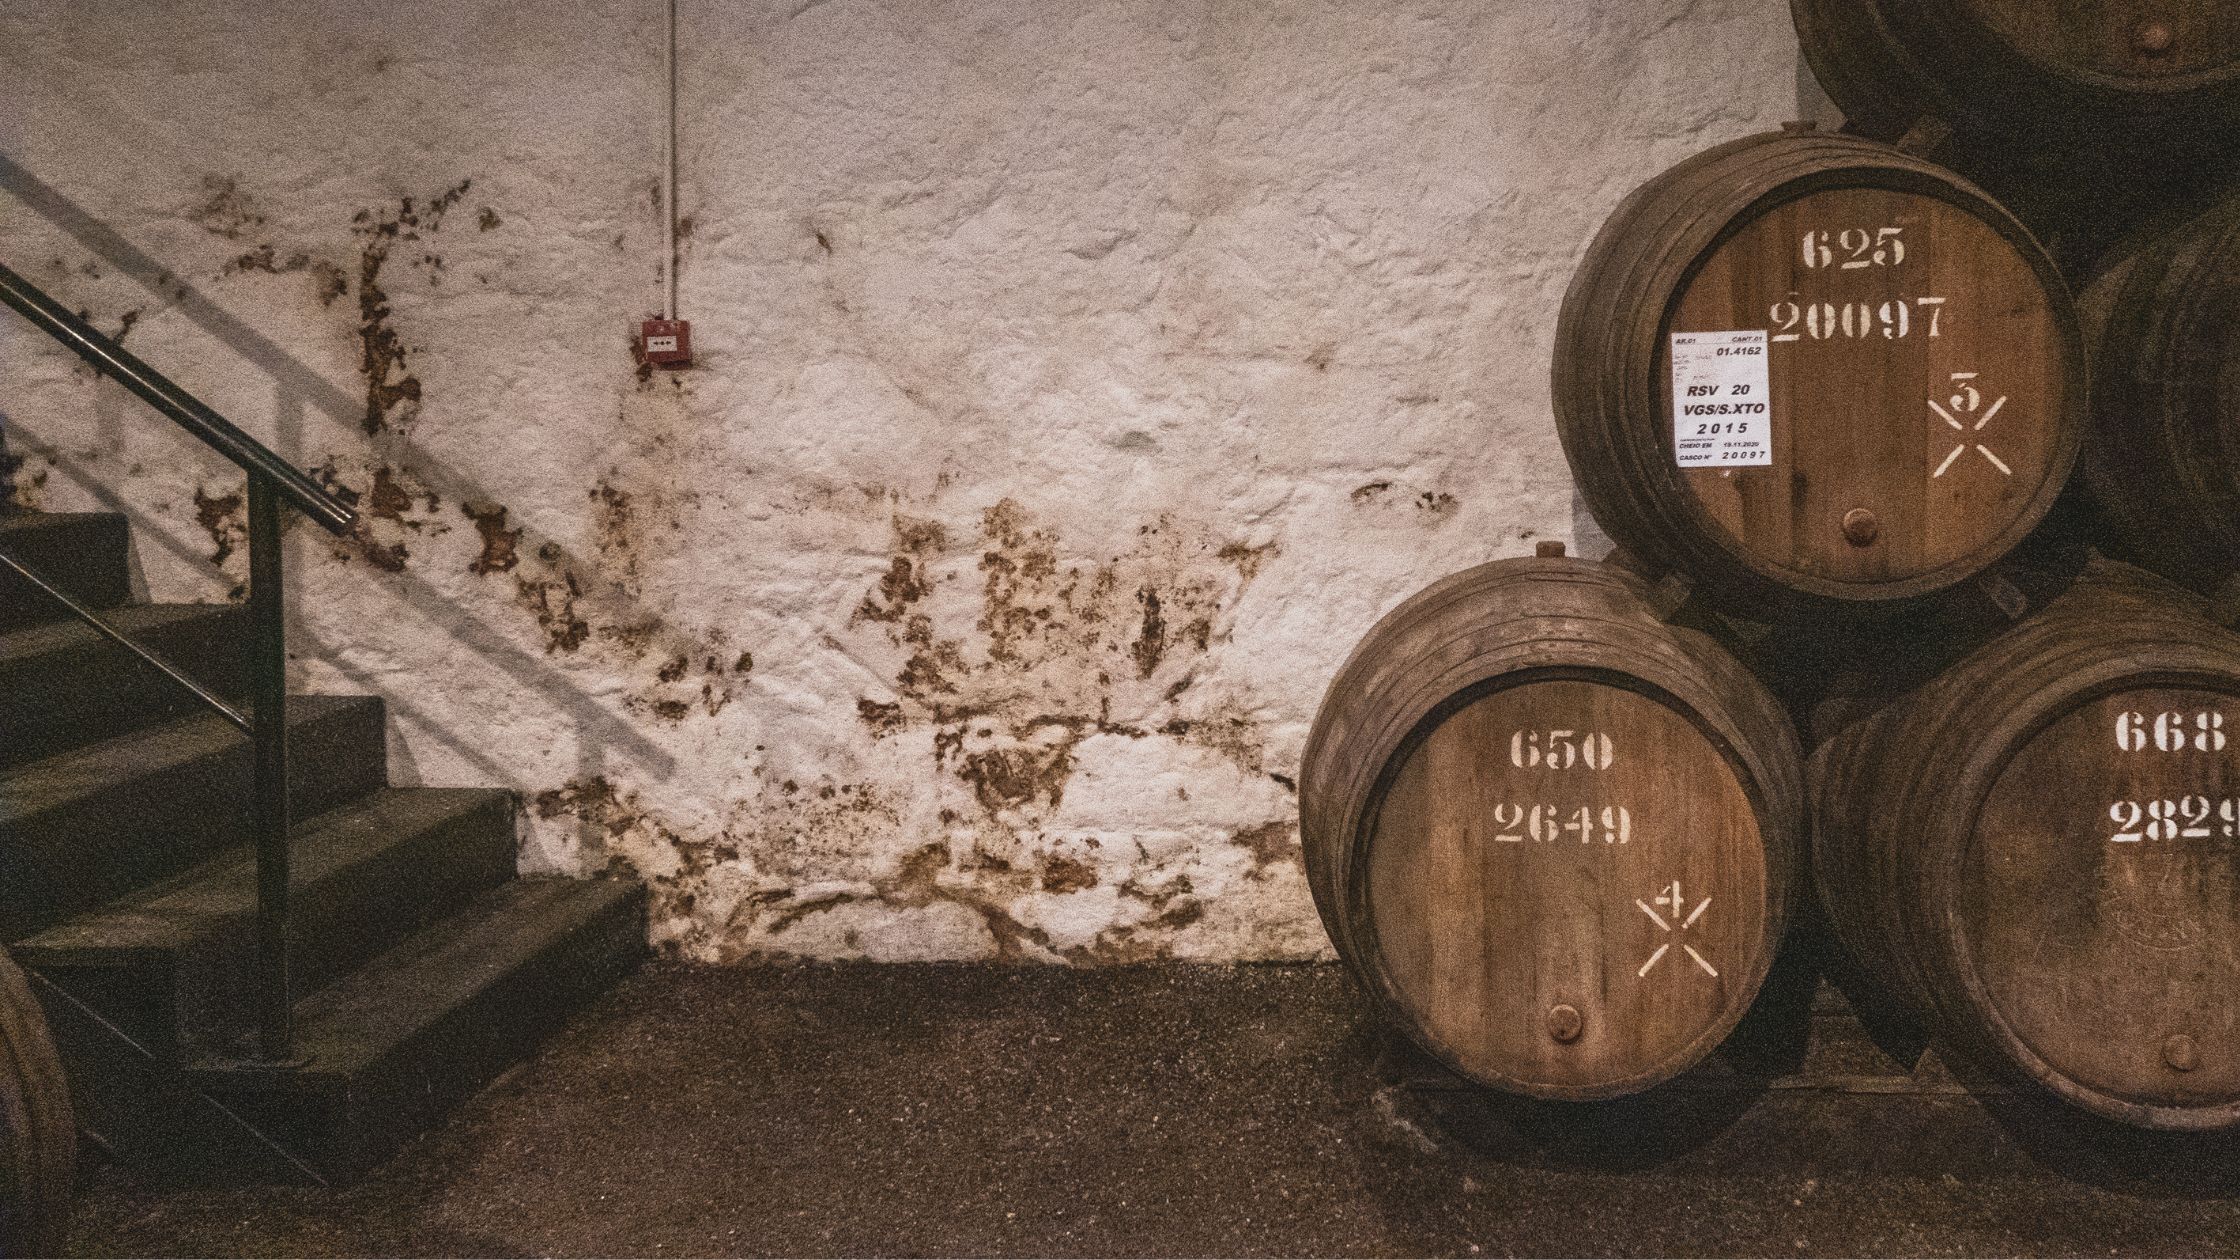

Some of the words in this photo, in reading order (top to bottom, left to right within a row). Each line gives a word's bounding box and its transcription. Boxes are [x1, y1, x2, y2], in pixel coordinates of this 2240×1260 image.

[1803, 227, 1905, 269] 625
[1770, 297, 1946, 342] 20097
[1716, 346, 1762, 356] 01.4162
[1684, 403, 1765, 416] VGS/S.XTO
[1687, 385, 1720, 397] RSV
[1731, 384, 1751, 395] 20
[1697, 423, 1748, 435] 2015
[1722, 451, 1766, 460] 20097
[1511, 730, 1613, 770] 650
[2115, 711, 2226, 752] 668
[1494, 803, 1631, 844] 2649
[1655, 880, 1684, 918] 4
